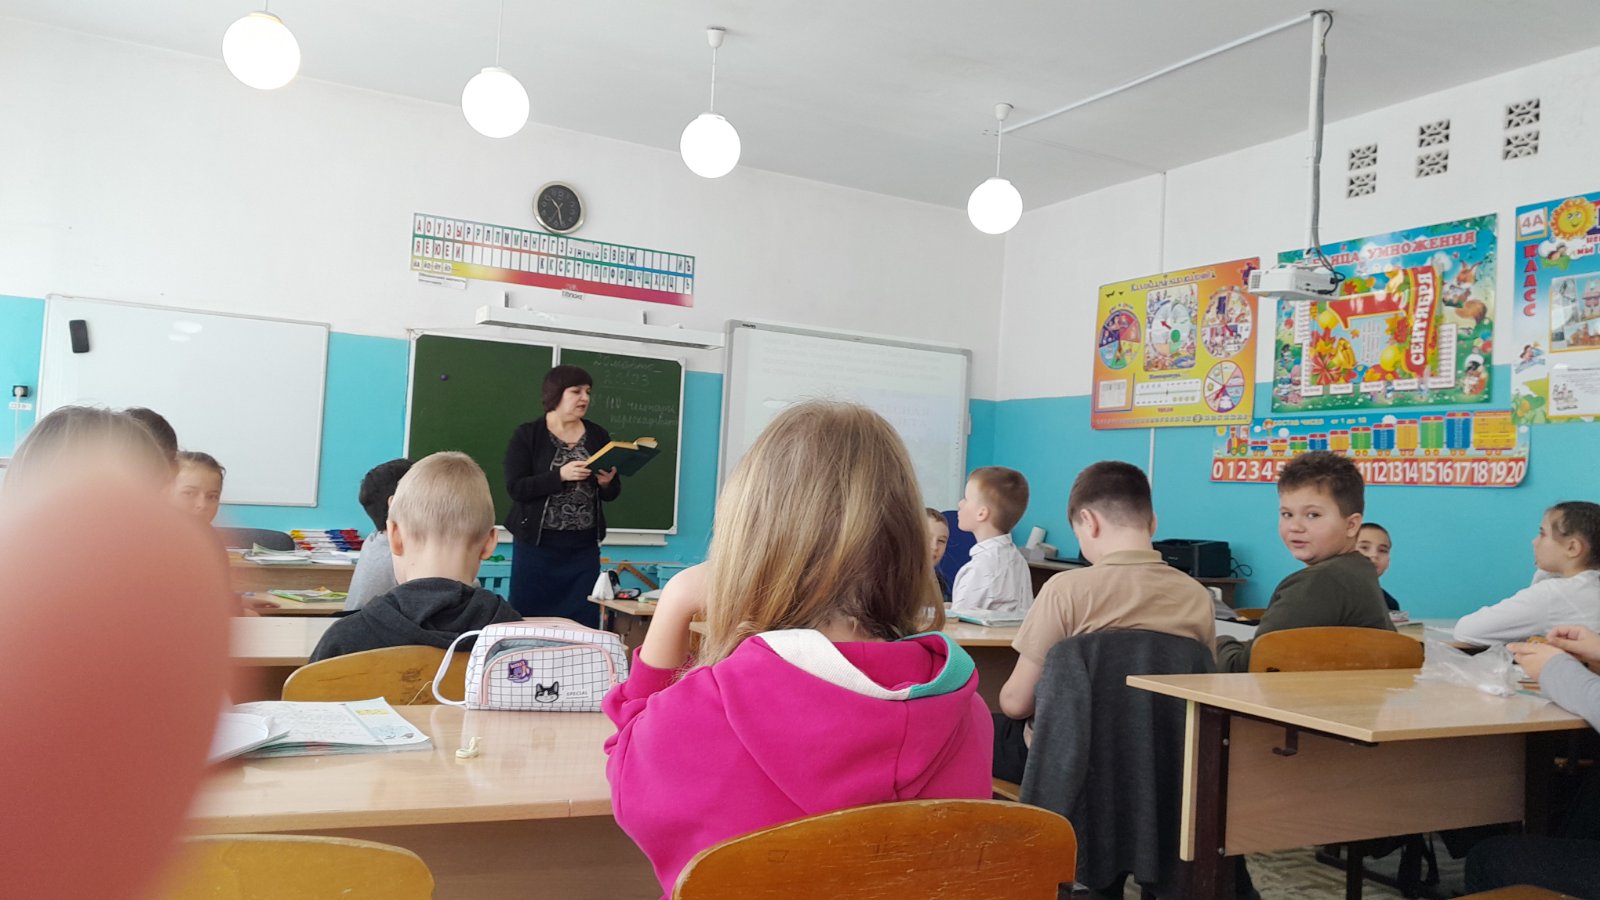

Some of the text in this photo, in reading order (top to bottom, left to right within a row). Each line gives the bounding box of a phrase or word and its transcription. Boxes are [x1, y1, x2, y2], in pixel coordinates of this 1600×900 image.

[1368, 231, 1475, 259] УМНОЖЕНИЯ
[1524, 244, 1539, 316] КЛАСС
[1411, 272, 1434, 365] СЕНТЯБРЯ
[1213, 461, 1223, 478] 0
[1228, 461, 1234, 478] 1
[1237, 462, 1246, 479] 2
[1250, 461, 1259, 479] 3
[1262, 462, 1273, 479] 4
[1373, 461, 1387, 482] 12
[1388, 461, 1402, 482] 13
[1403, 461, 1418, 482] 14
[1420, 461, 1436, 482] 15
[1437, 461, 1453, 482] 16
[1454, 461, 1471, 482] 17
[1472, 461, 1488, 482] 18
[1490, 461, 1507, 482] 19
[1506, 461, 1525, 482] 20
